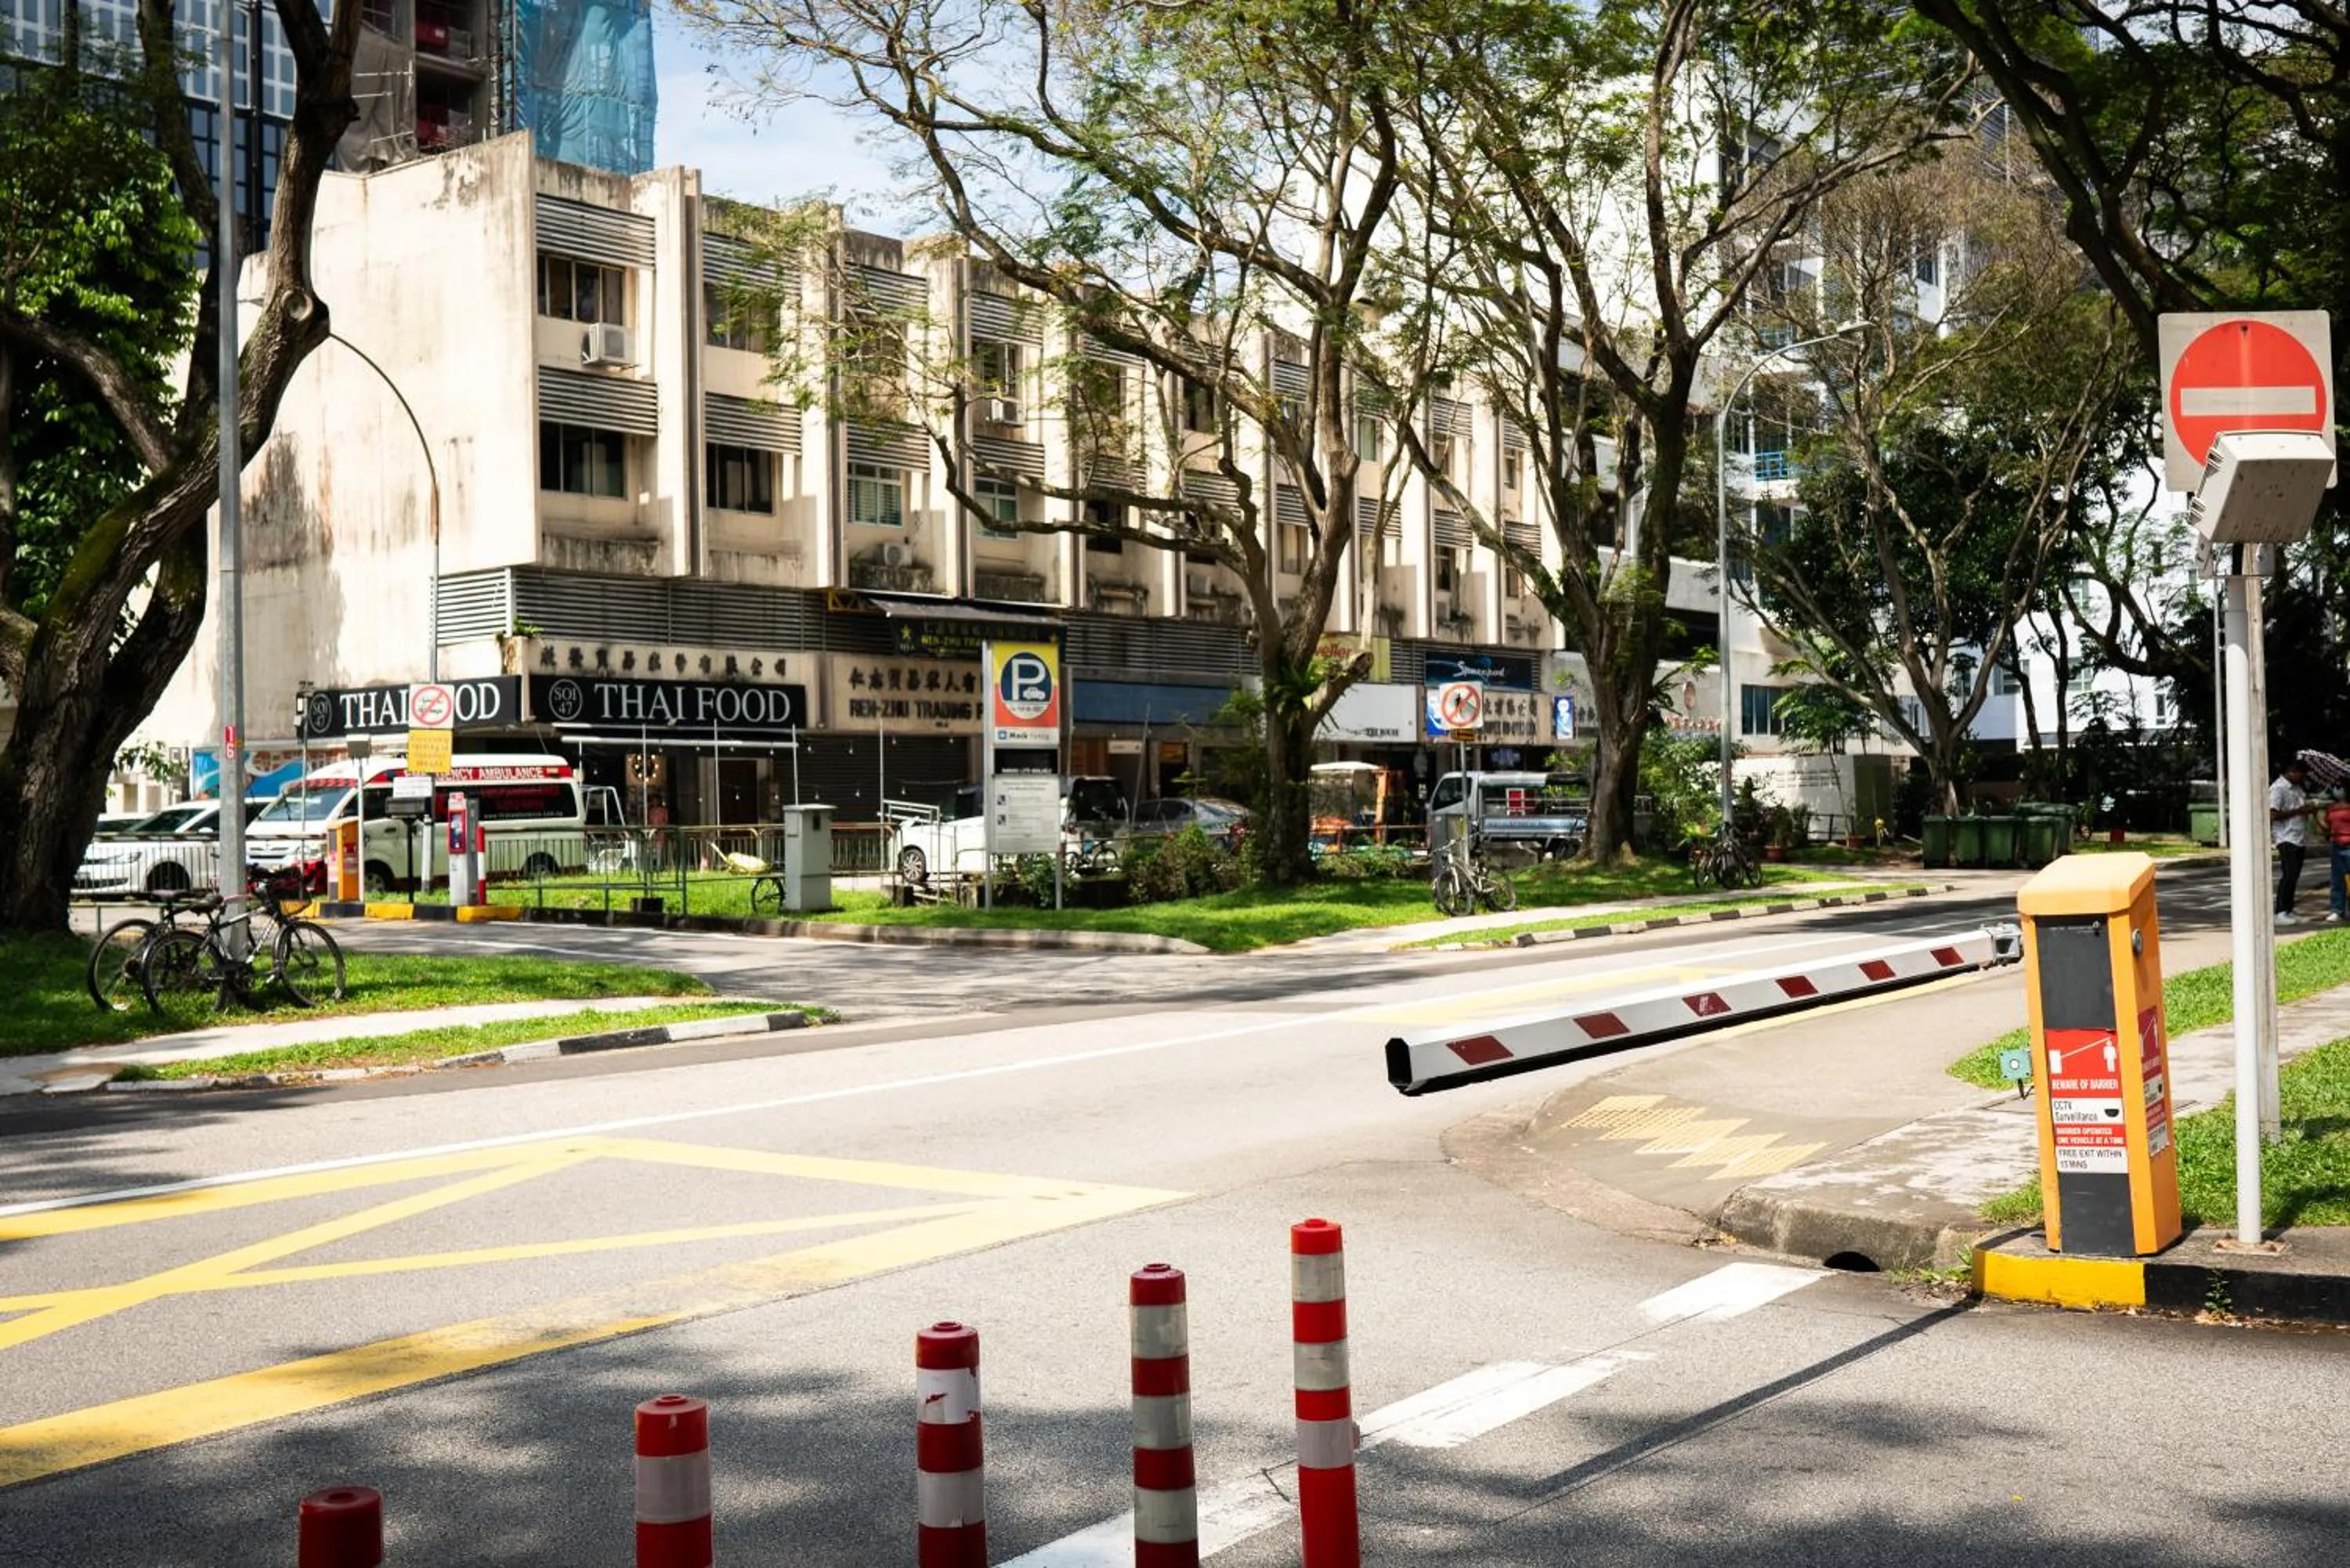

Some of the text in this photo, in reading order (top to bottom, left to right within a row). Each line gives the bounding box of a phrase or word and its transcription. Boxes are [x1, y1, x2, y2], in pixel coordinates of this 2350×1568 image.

[1011, 658, 1046, 702] P
[554, 686, 576, 699] SOI
[339, 683, 501, 728] THAI OD
[559, 700, 573, 714] 47
[595, 684, 790, 722] THAI FOOD
[914, 701, 971, 719] TRADING
[479, 767, 544, 780] AMBULANCE
[2080, 1078, 2088, 1090] OF
[2089, 1078, 2119, 1089] BARRIER
[2053, 1100, 2072, 1110] CCTV
[2059, 1149, 2122, 1158] FREE EXIT WITHIN
[2060, 1160, 2088, 1169] 15 MINS
